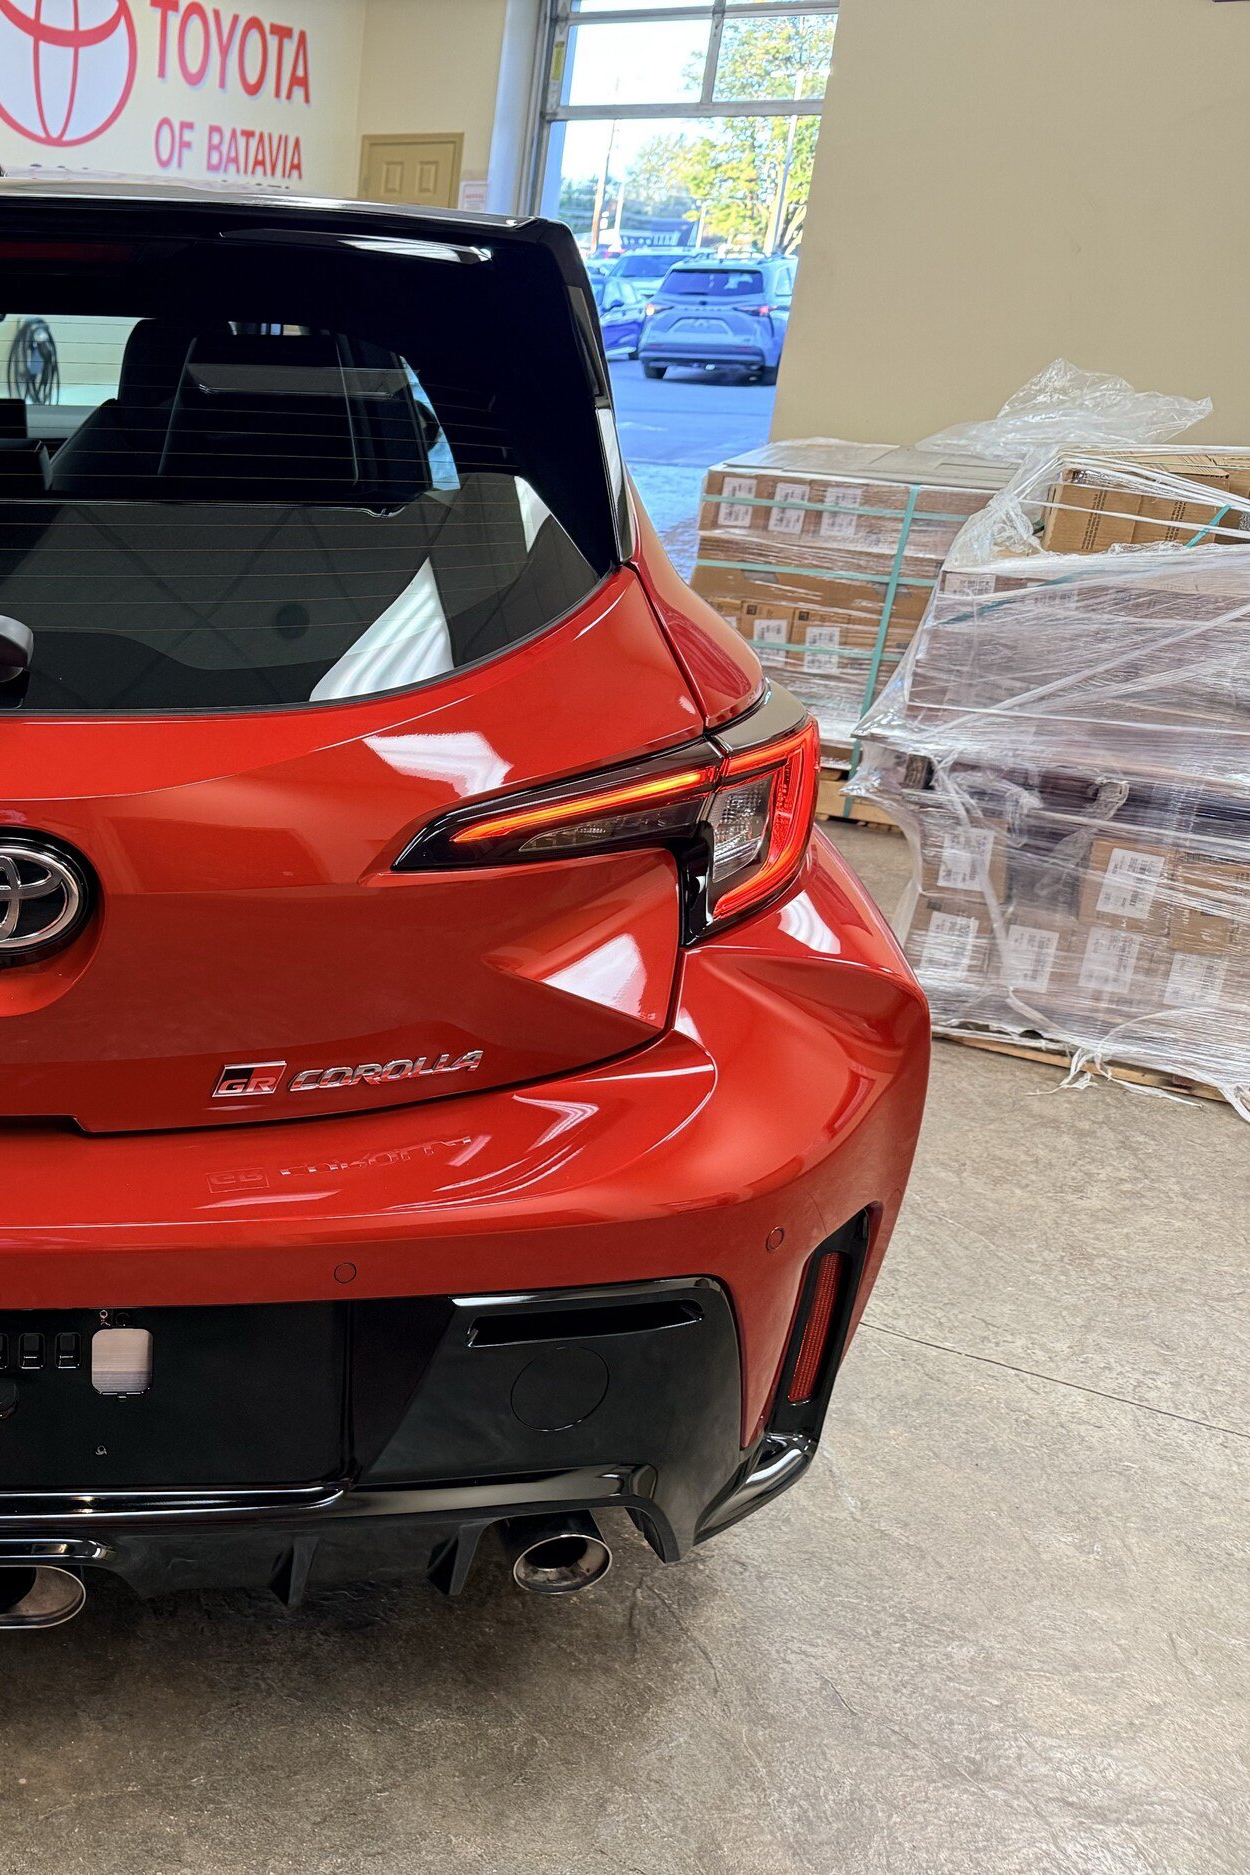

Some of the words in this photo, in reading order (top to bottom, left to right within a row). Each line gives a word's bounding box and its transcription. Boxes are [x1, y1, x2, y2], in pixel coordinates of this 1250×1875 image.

[150, 0, 310, 104] TOYOTA
[154, 117, 194, 168] OF
[206, 124, 302, 180] BATAVIA
[289, 1050, 483, 1091] COROLLA
